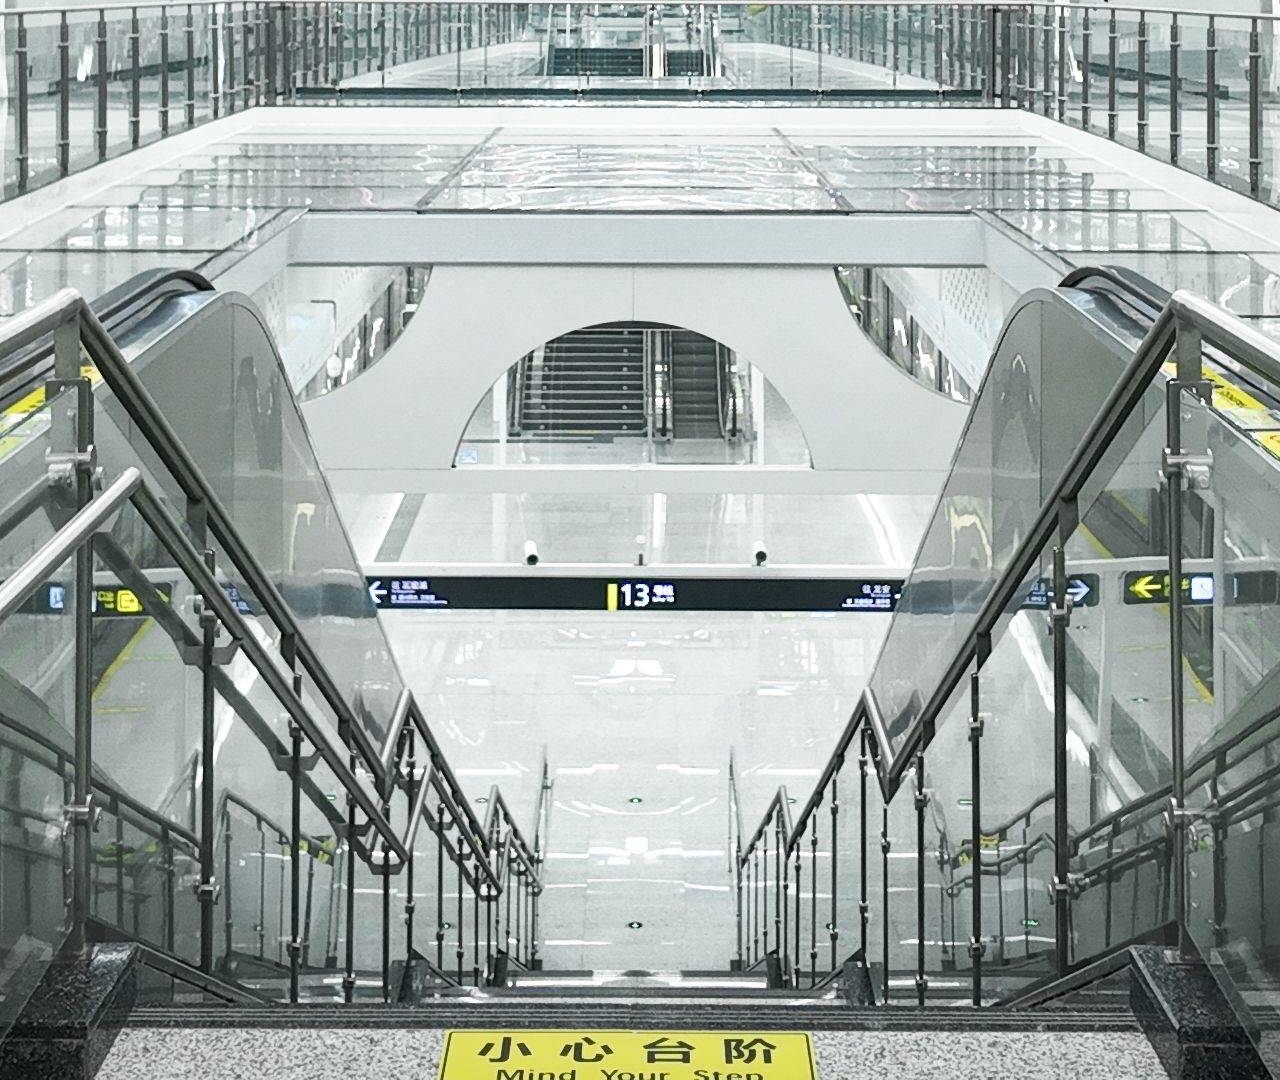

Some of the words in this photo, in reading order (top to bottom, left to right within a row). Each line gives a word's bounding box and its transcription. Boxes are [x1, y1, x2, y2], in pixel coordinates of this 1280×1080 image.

[620, 583, 650, 607] 13
[477, 1036, 777, 1065] 小心台阶
[496, 1069, 576, 1080] Mind
